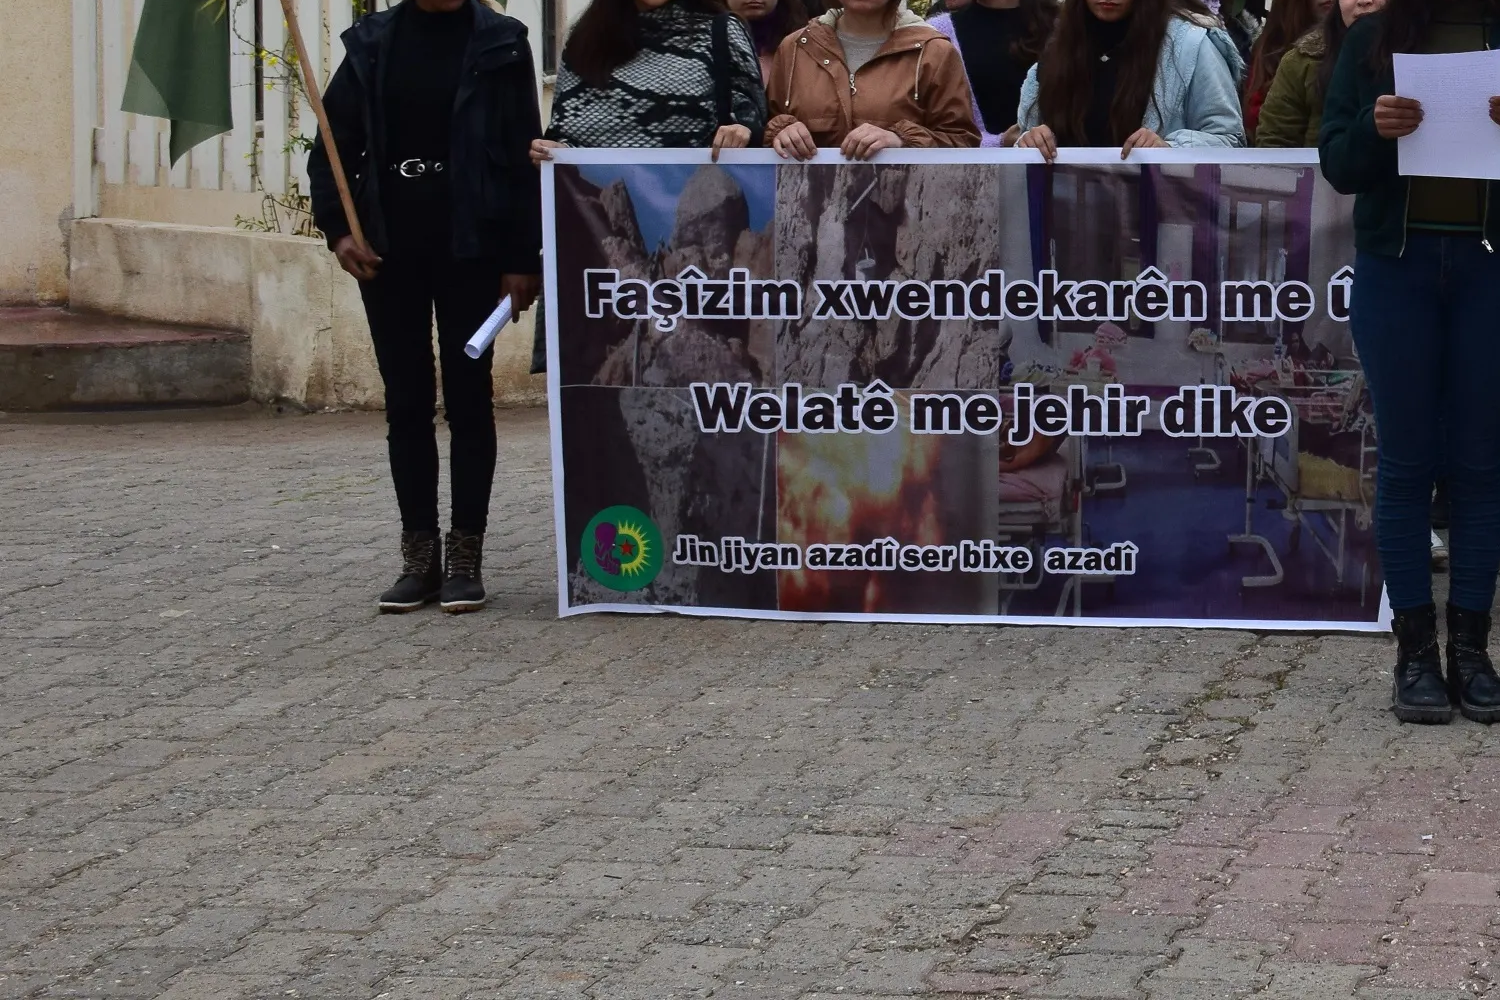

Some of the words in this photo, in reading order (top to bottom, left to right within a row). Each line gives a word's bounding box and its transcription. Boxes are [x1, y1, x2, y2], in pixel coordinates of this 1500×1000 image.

[583, 265, 801, 332] Faşîzim
[812, 265, 1208, 323] xwendekarên
[1220, 279, 1315, 323] me
[690, 379, 899, 435] Welatê
[910, 393, 1002, 437] me
[1008, 383, 1150, 446] jehir
[1160, 385, 1292, 438] dike
[673, 535, 718, 566] Jin
[720, 537, 802, 574] jiyan
[805, 536, 899, 572] azadî
[899, 543, 956, 572] ser
[959, 538, 1033, 573] bixe
[1044, 540, 1139, 575] azadî
